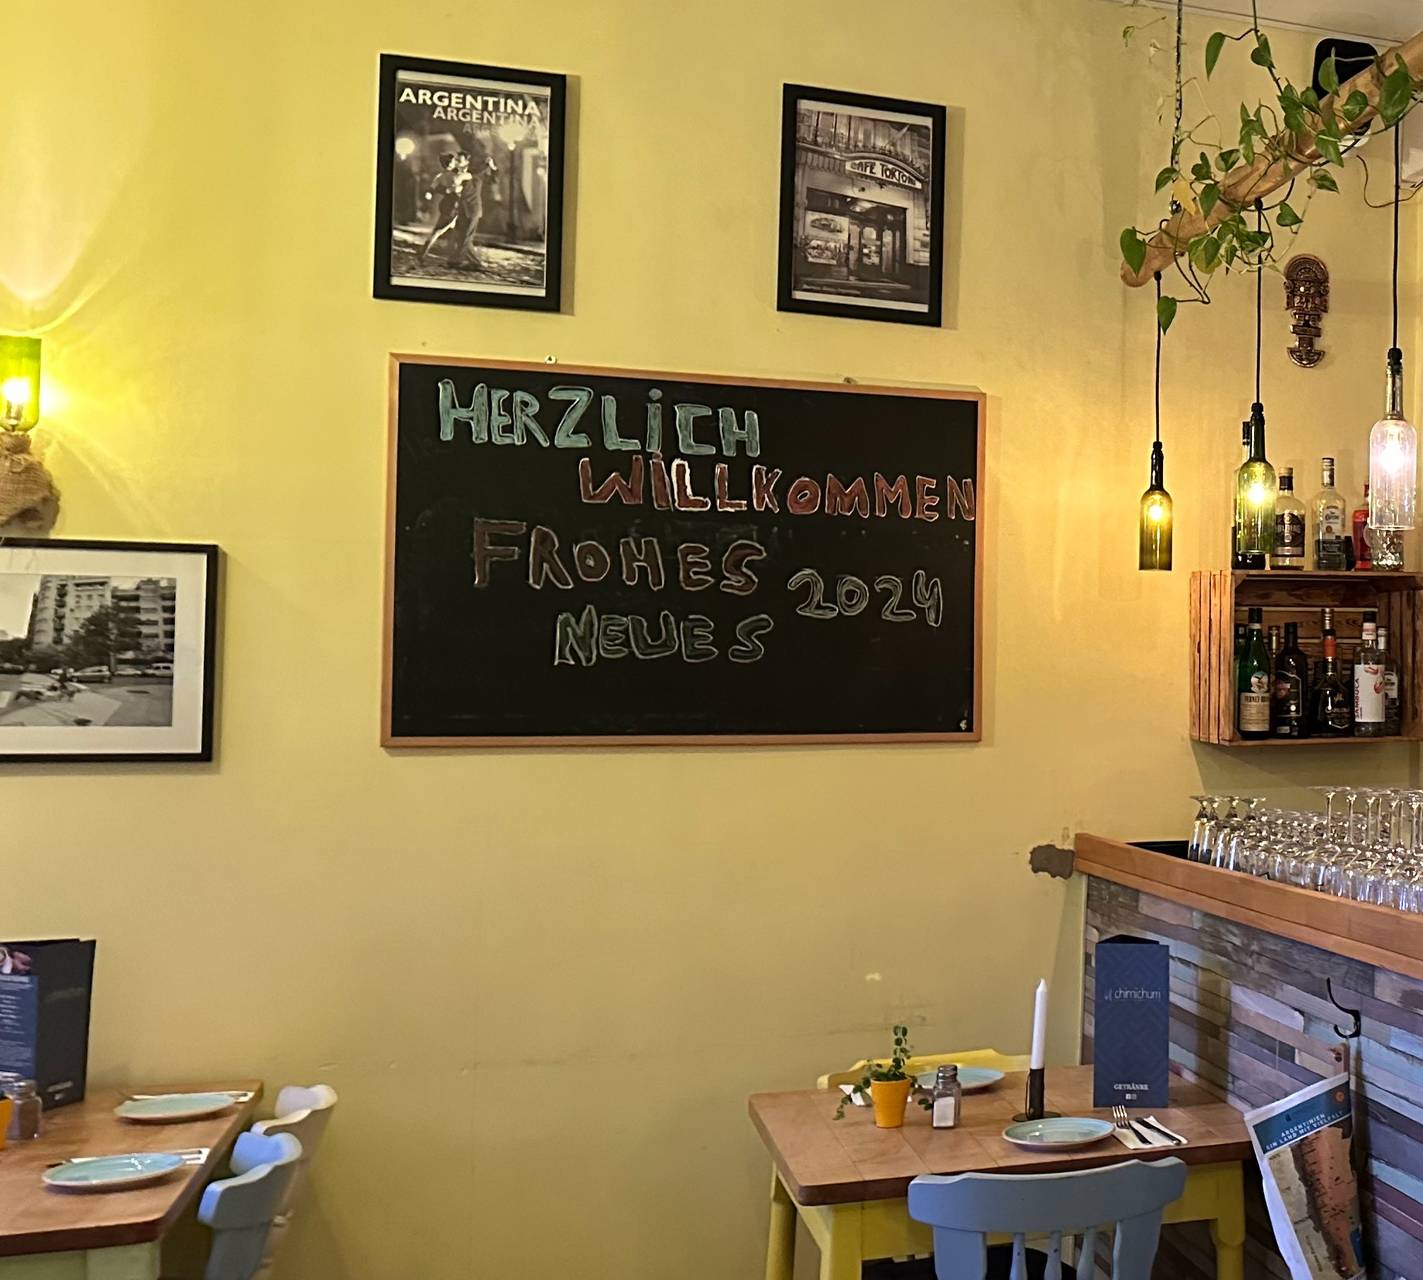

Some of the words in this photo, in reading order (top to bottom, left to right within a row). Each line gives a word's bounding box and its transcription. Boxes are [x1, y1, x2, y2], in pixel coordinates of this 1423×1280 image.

[399, 87, 542, 117] ARGENTINA
[433, 106, 541, 129] ARGENTINA
[473, 518, 768, 596] FROHES
[787, 568, 944, 627] 2024
[554, 605, 775, 667] NEUES
[1279, 1133, 1297, 1144] LAND
[1299, 1126, 1311, 1135] MIT
[1281, 1113, 1326, 1137] ARGENTINIEN
